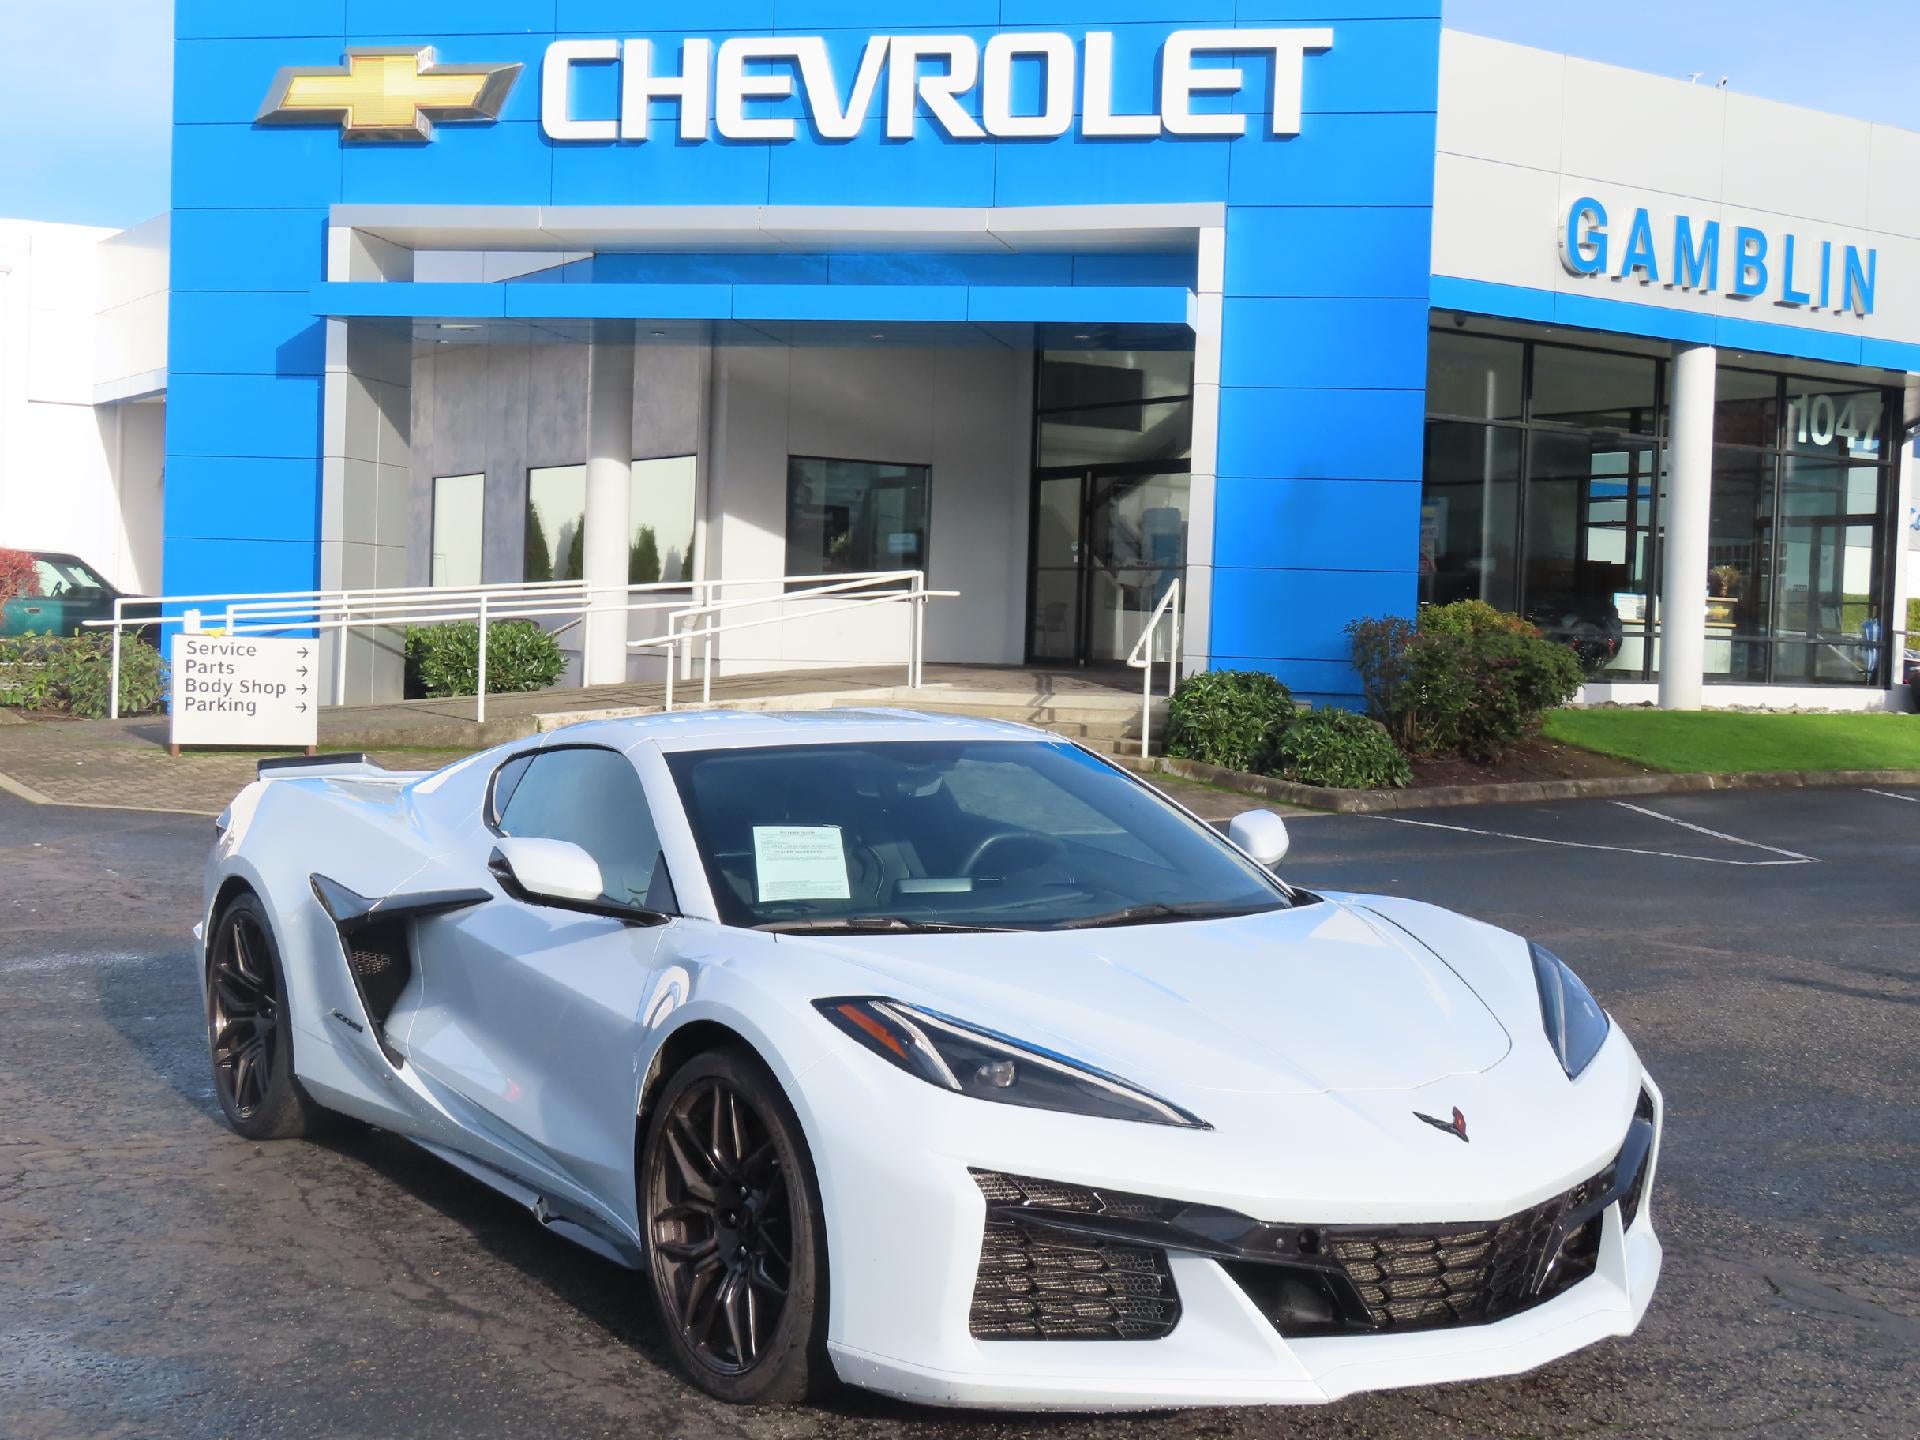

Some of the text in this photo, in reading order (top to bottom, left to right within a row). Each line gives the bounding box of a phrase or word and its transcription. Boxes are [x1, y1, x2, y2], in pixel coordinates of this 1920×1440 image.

[541, 27, 1333, 141] CHEVROLET
[1563, 196, 1877, 317] GAMBLIN
[1793, 394, 1884, 450] 1047
[186, 640, 257, 657] Service
[185, 659, 235, 675] Parts
[185, 678, 286, 699] Body Shop
[185, 697, 257, 717] Parking
